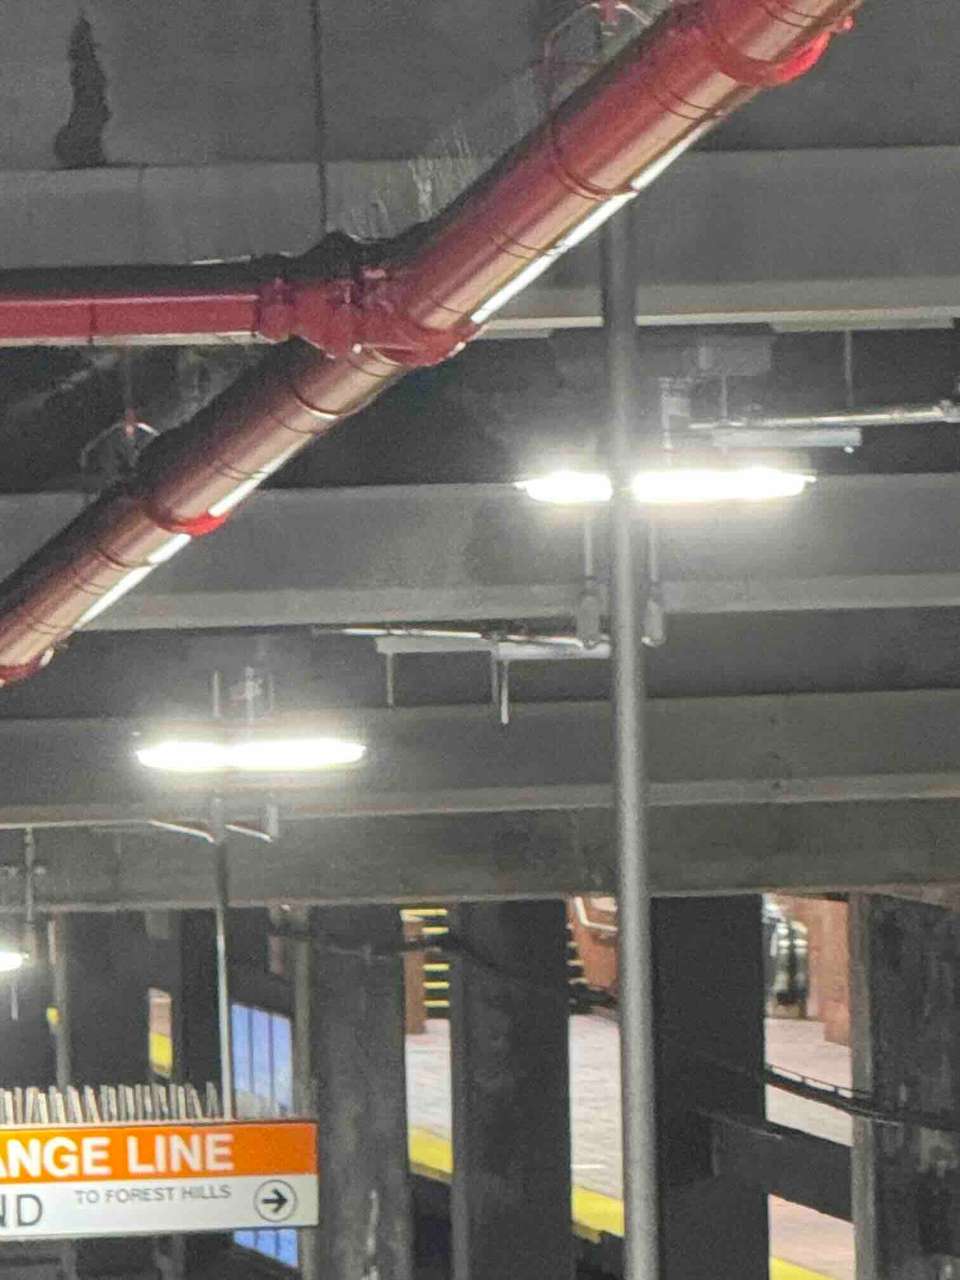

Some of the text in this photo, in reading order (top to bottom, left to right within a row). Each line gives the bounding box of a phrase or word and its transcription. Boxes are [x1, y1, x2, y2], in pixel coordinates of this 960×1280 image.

[0, 1133, 234, 1178] NGE LINE
[75, 1184, 231, 1204] TO FOREST HILLS
